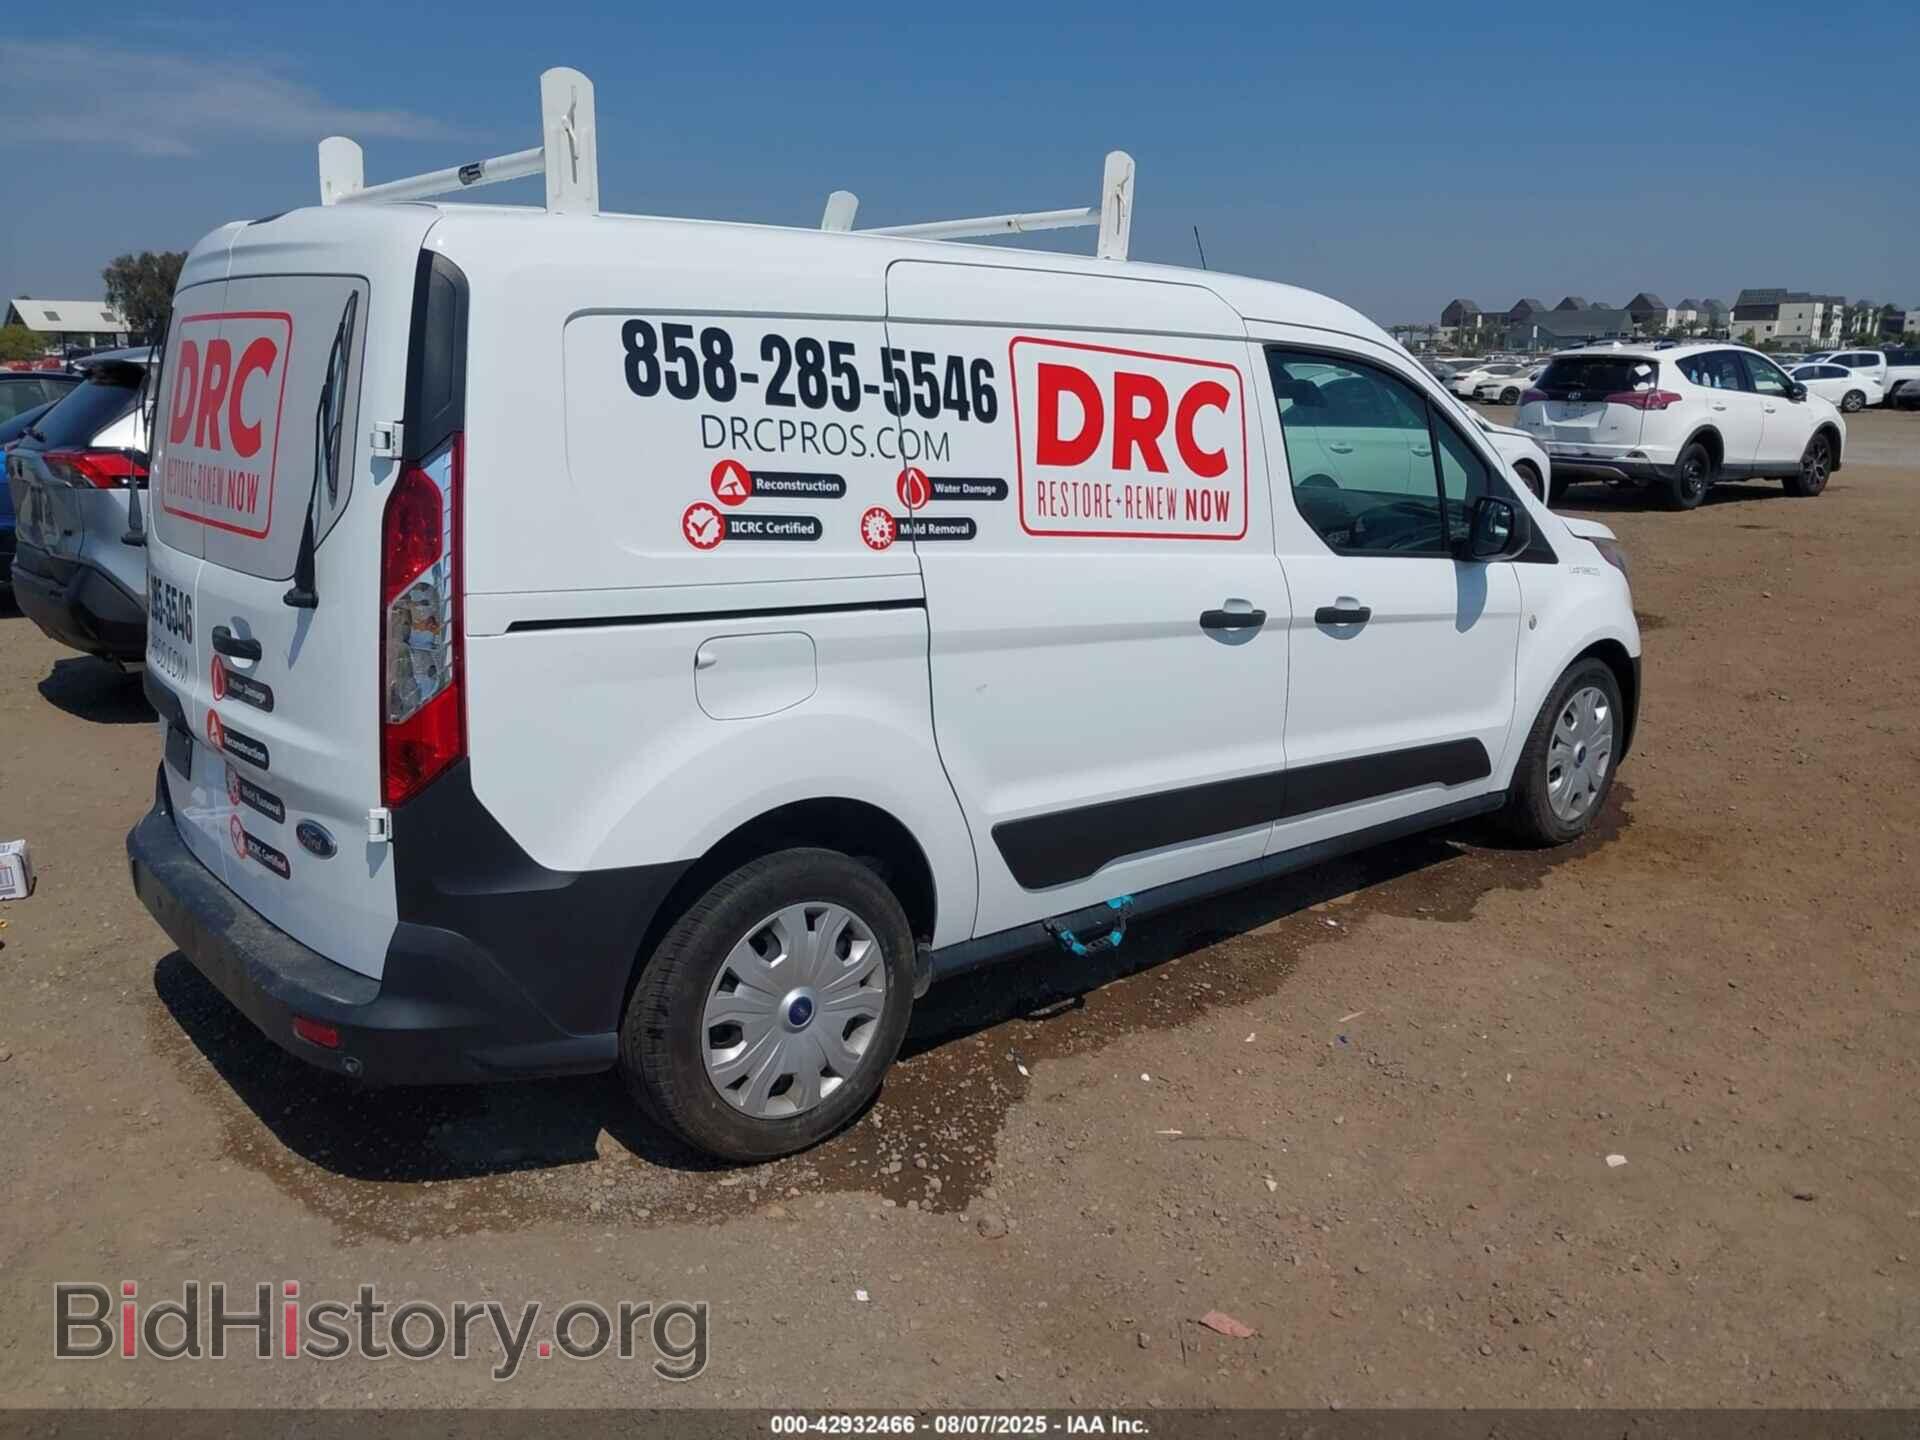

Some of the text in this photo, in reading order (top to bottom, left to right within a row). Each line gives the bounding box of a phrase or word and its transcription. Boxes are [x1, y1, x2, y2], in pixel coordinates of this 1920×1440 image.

[621, 318, 998, 424] 858-285-5546
[169, 336, 277, 458] DRC
[700, 414, 951, 462] DRCPROS.COM
[1036, 362, 1231, 478] DRC
[227, 469, 260, 514] NOW
[756, 478, 840, 492] Reconstruction
[934, 483, 997, 496] Water Damage
[1186, 489, 1230, 522] NOW
[731, 521, 815, 534] IICRC Certified
[928, 524, 970, 535] Removal
